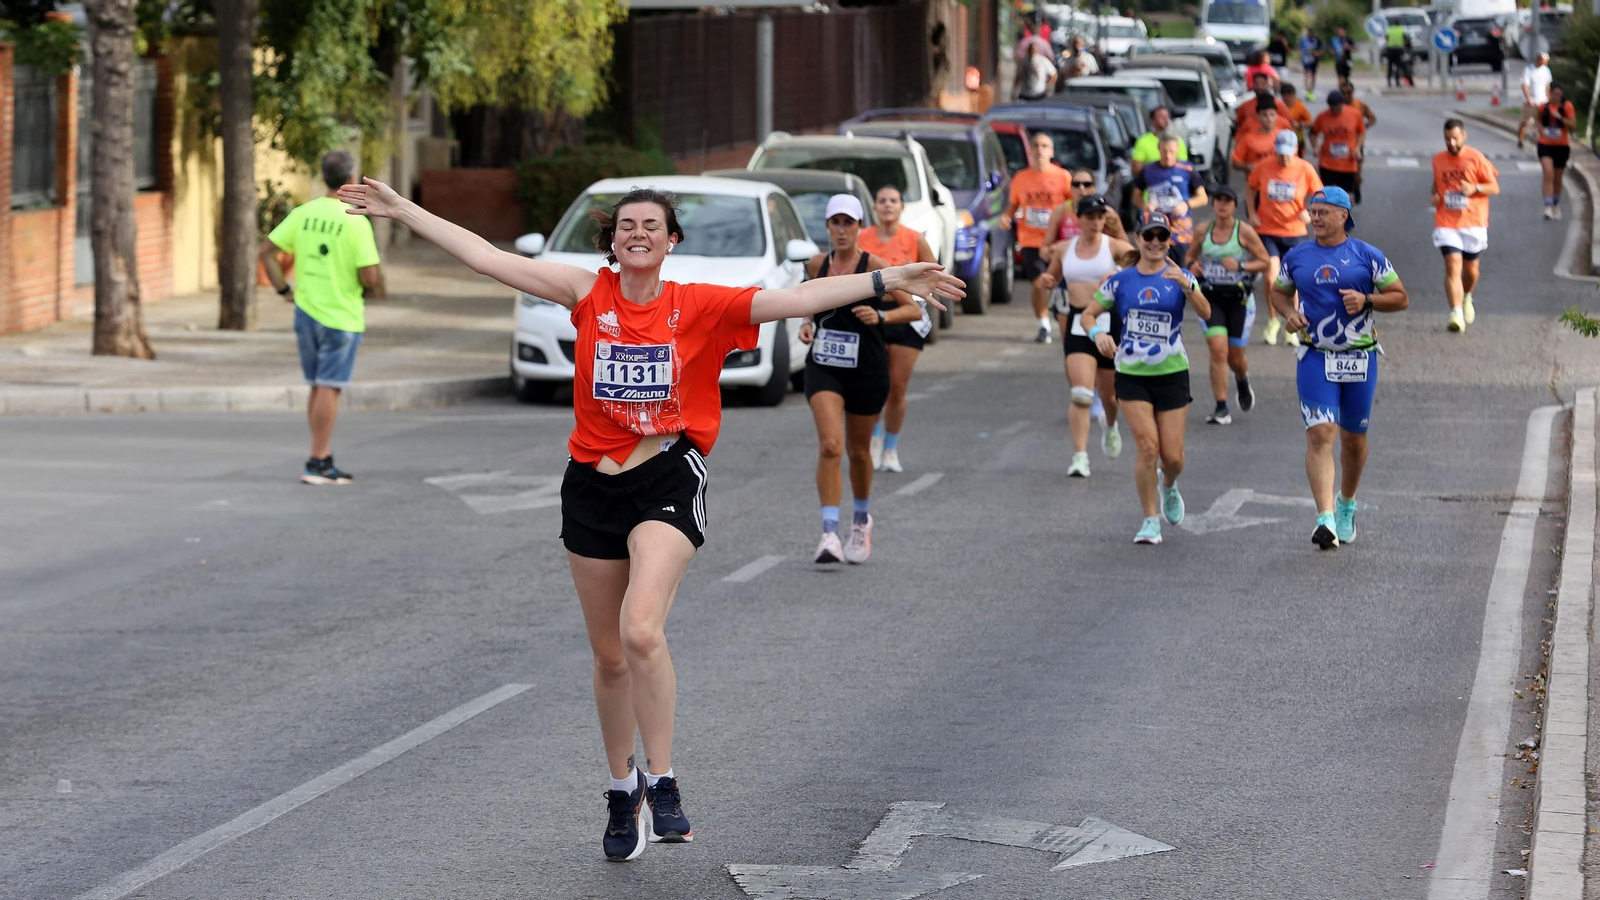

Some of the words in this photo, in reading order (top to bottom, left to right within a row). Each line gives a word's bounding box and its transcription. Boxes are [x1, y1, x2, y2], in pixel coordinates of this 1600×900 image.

[1138, 321, 1159, 333] 950
[823, 342, 845, 355] 588
[1336, 361, 1358, 371] 846
[607, 363, 657, 384] 1131
